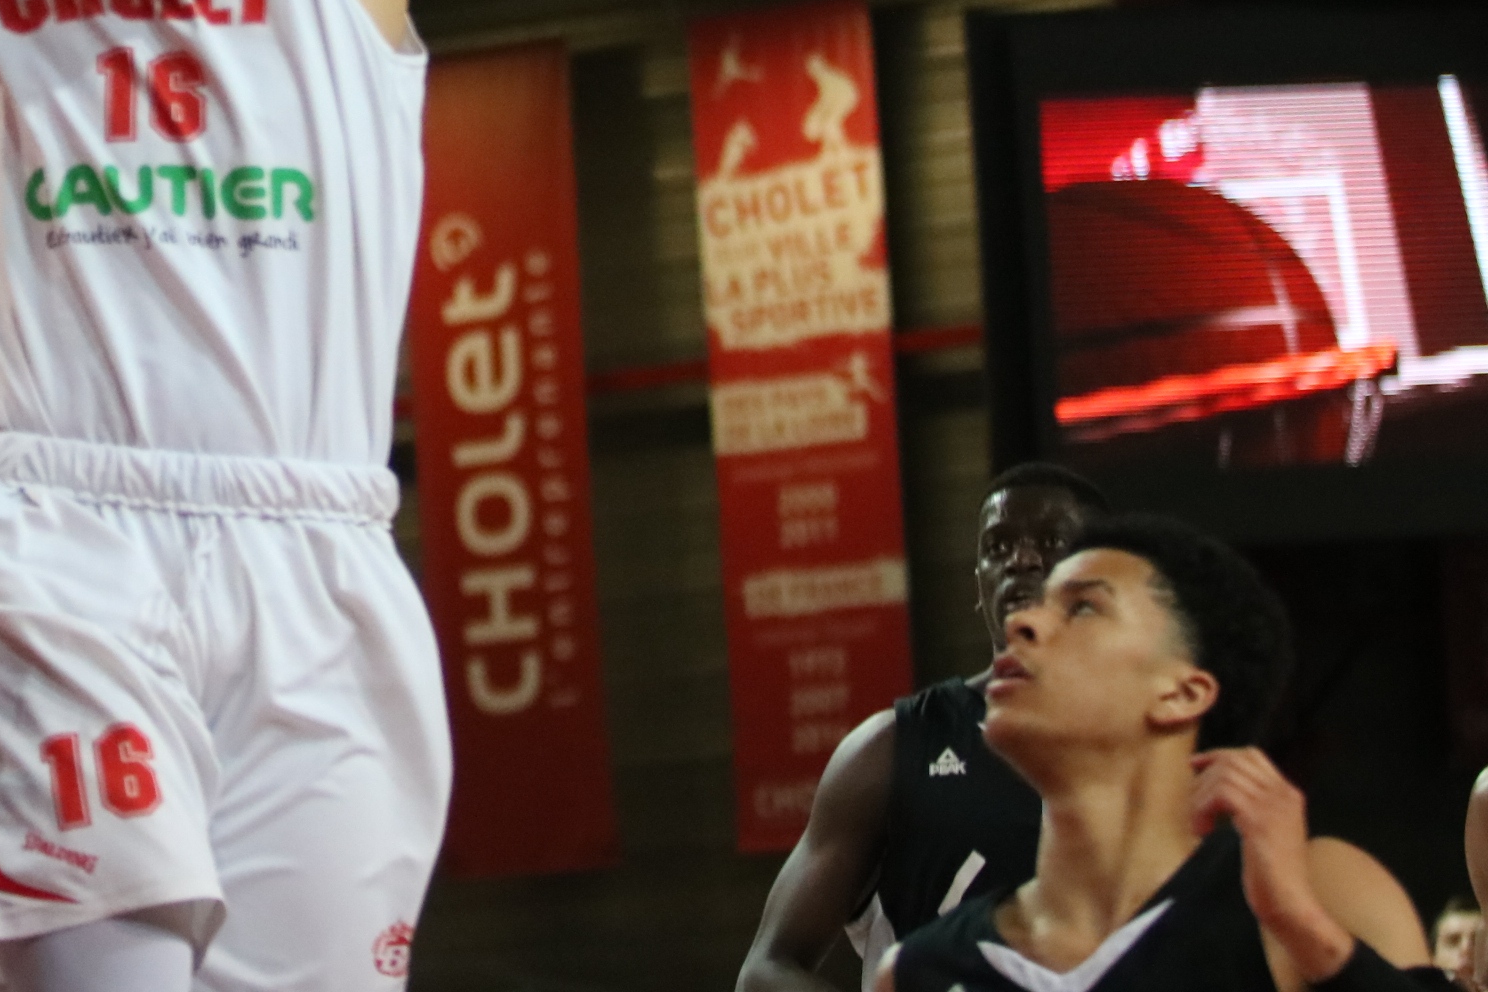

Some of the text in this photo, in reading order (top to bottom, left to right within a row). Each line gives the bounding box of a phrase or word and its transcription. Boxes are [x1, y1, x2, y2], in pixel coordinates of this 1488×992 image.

[97, 46, 207, 144] 16
[704, 162, 870, 239] CHOLET
[41, 722, 163, 832] 16
[929, 760, 967, 777] PEAK
[23, 832, 98, 875] SPALDING
